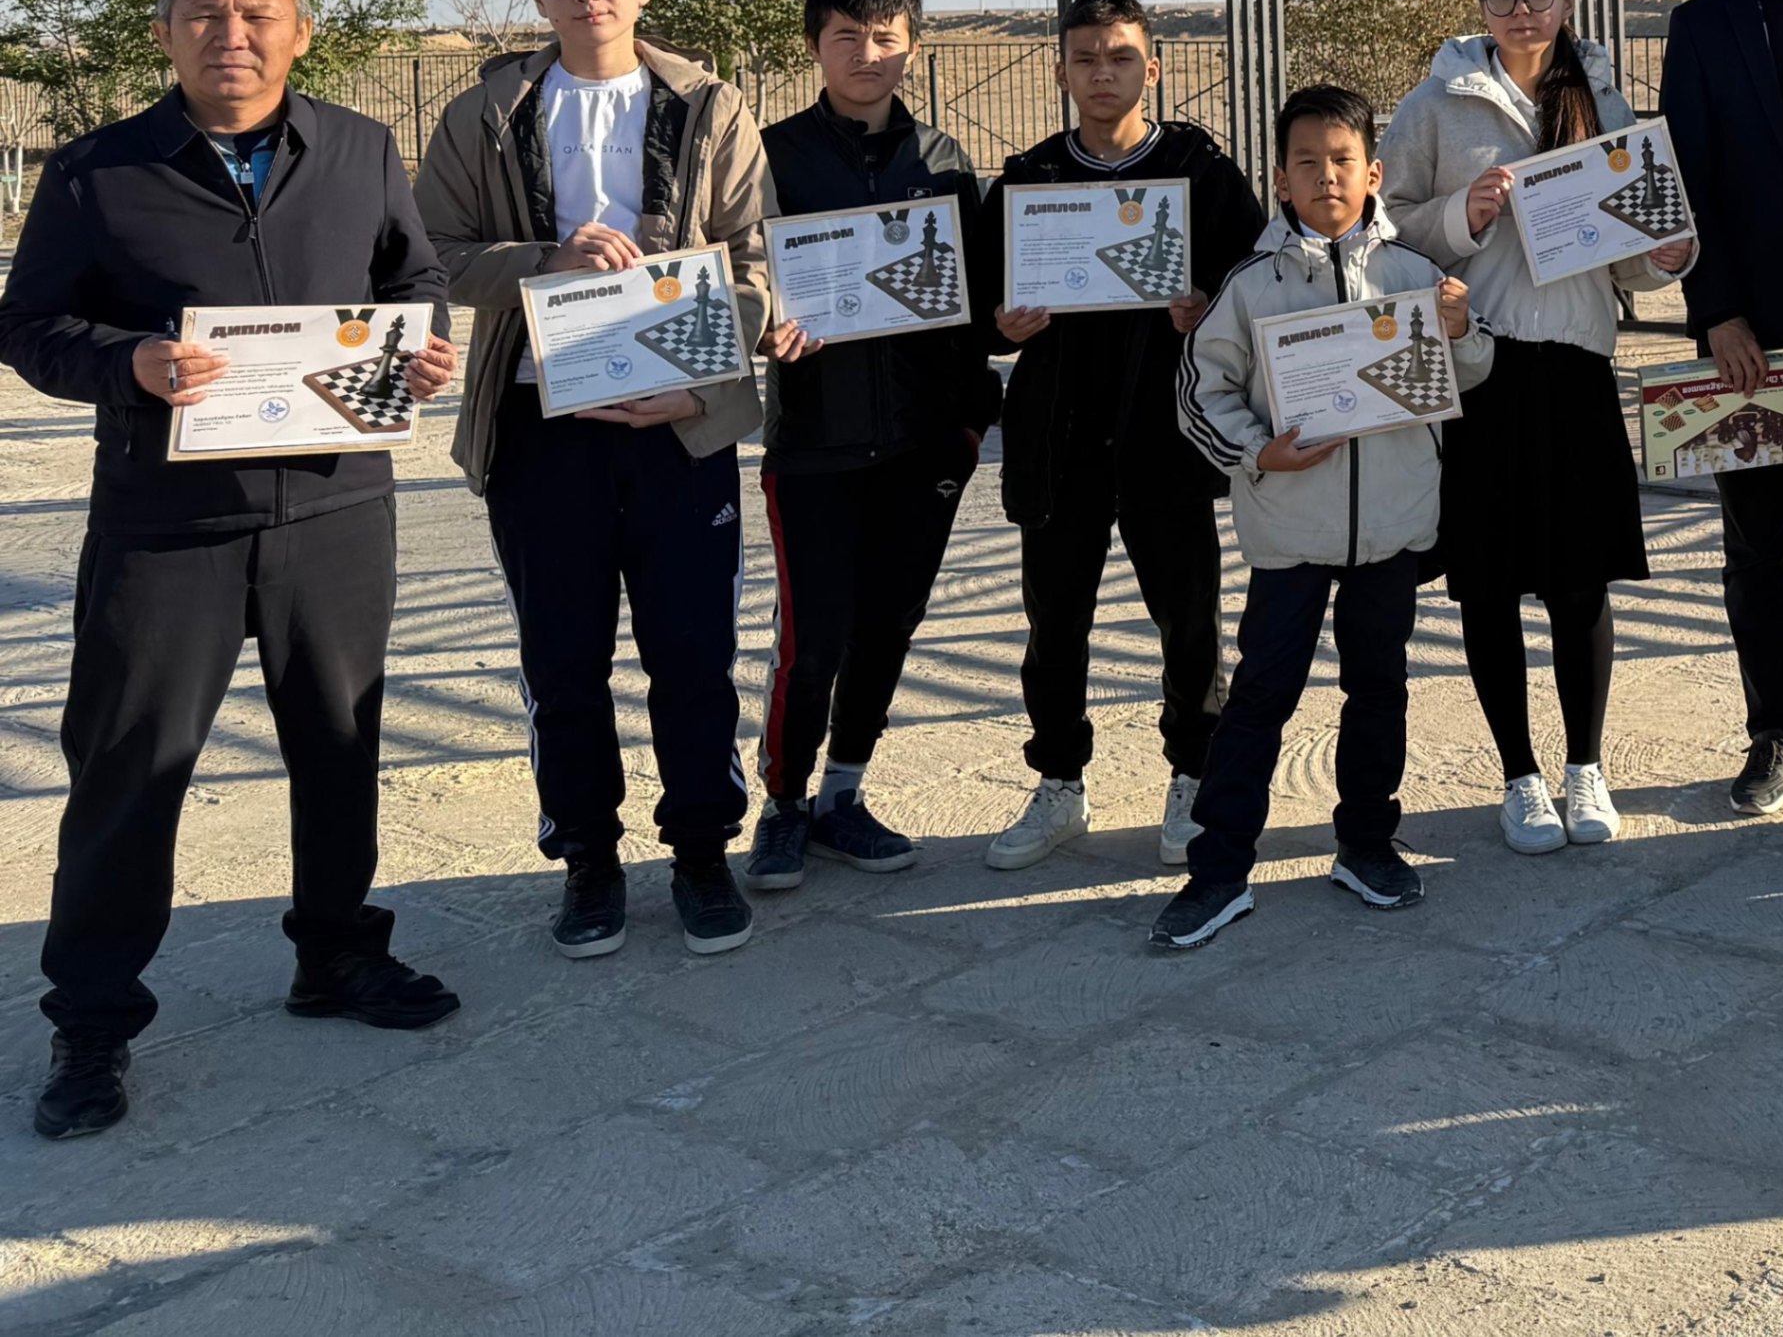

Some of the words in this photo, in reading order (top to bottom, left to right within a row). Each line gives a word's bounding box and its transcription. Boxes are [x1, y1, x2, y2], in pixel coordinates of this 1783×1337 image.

[1524, 160, 1583, 188] ДИПЛОМ
[1024, 202, 1092, 216] ДИПЛОМ
[784, 227, 854, 249] ДИПЛОМ
[547, 283, 623, 308] ДИПЛОМ
[209, 322, 302, 340] ДИПЛОМ
[1278, 323, 1345, 348] ДИПЛОМ
[712, 513, 737, 526] adidas
